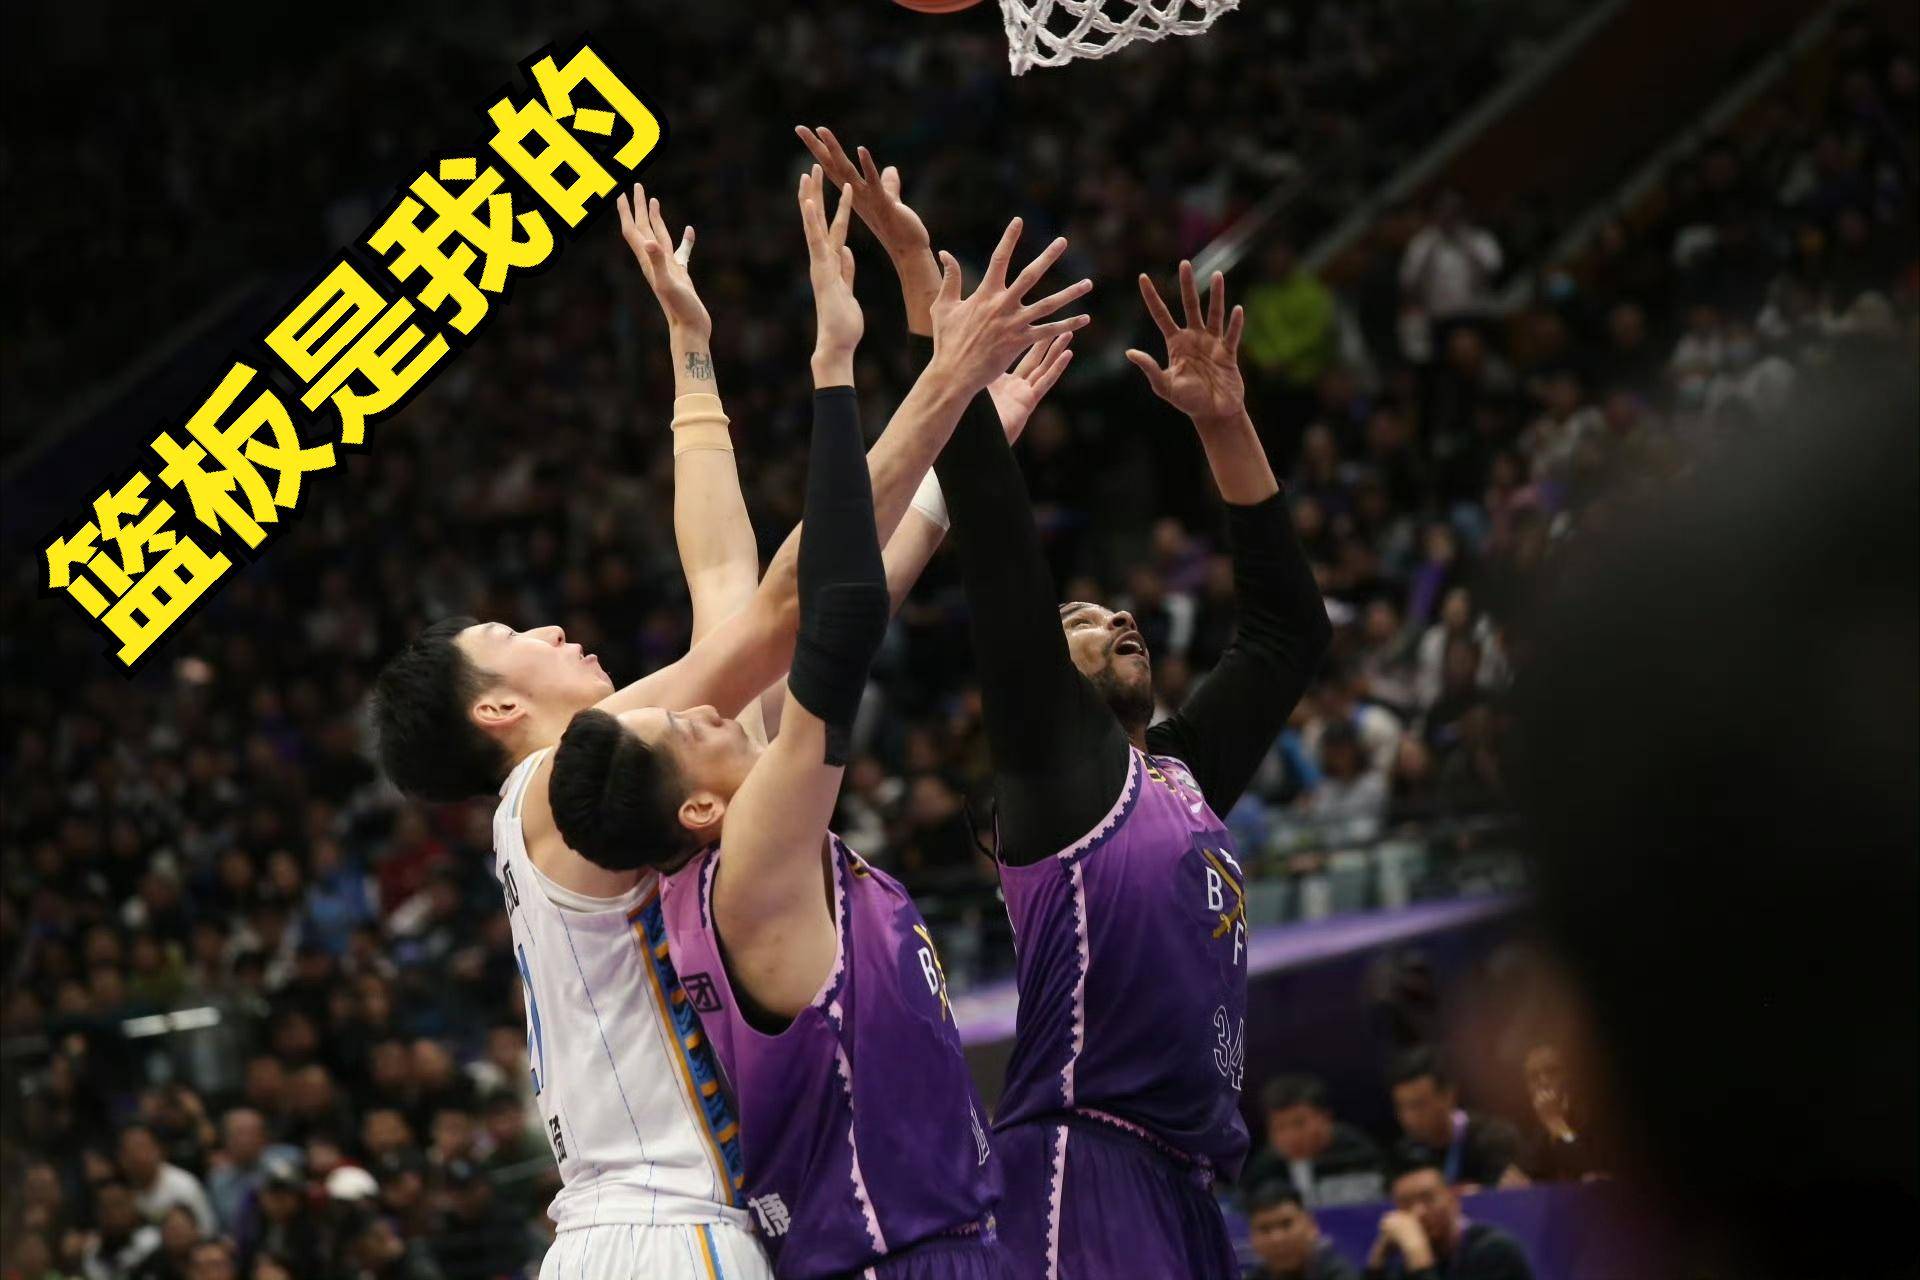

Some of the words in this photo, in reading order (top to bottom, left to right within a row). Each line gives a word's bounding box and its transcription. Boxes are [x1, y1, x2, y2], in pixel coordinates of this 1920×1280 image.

[1205, 866, 1224, 912] B
[680, 971, 723, 1012] 团
[917, 946, 940, 997] B
[1213, 1004, 1245, 1092] 34
